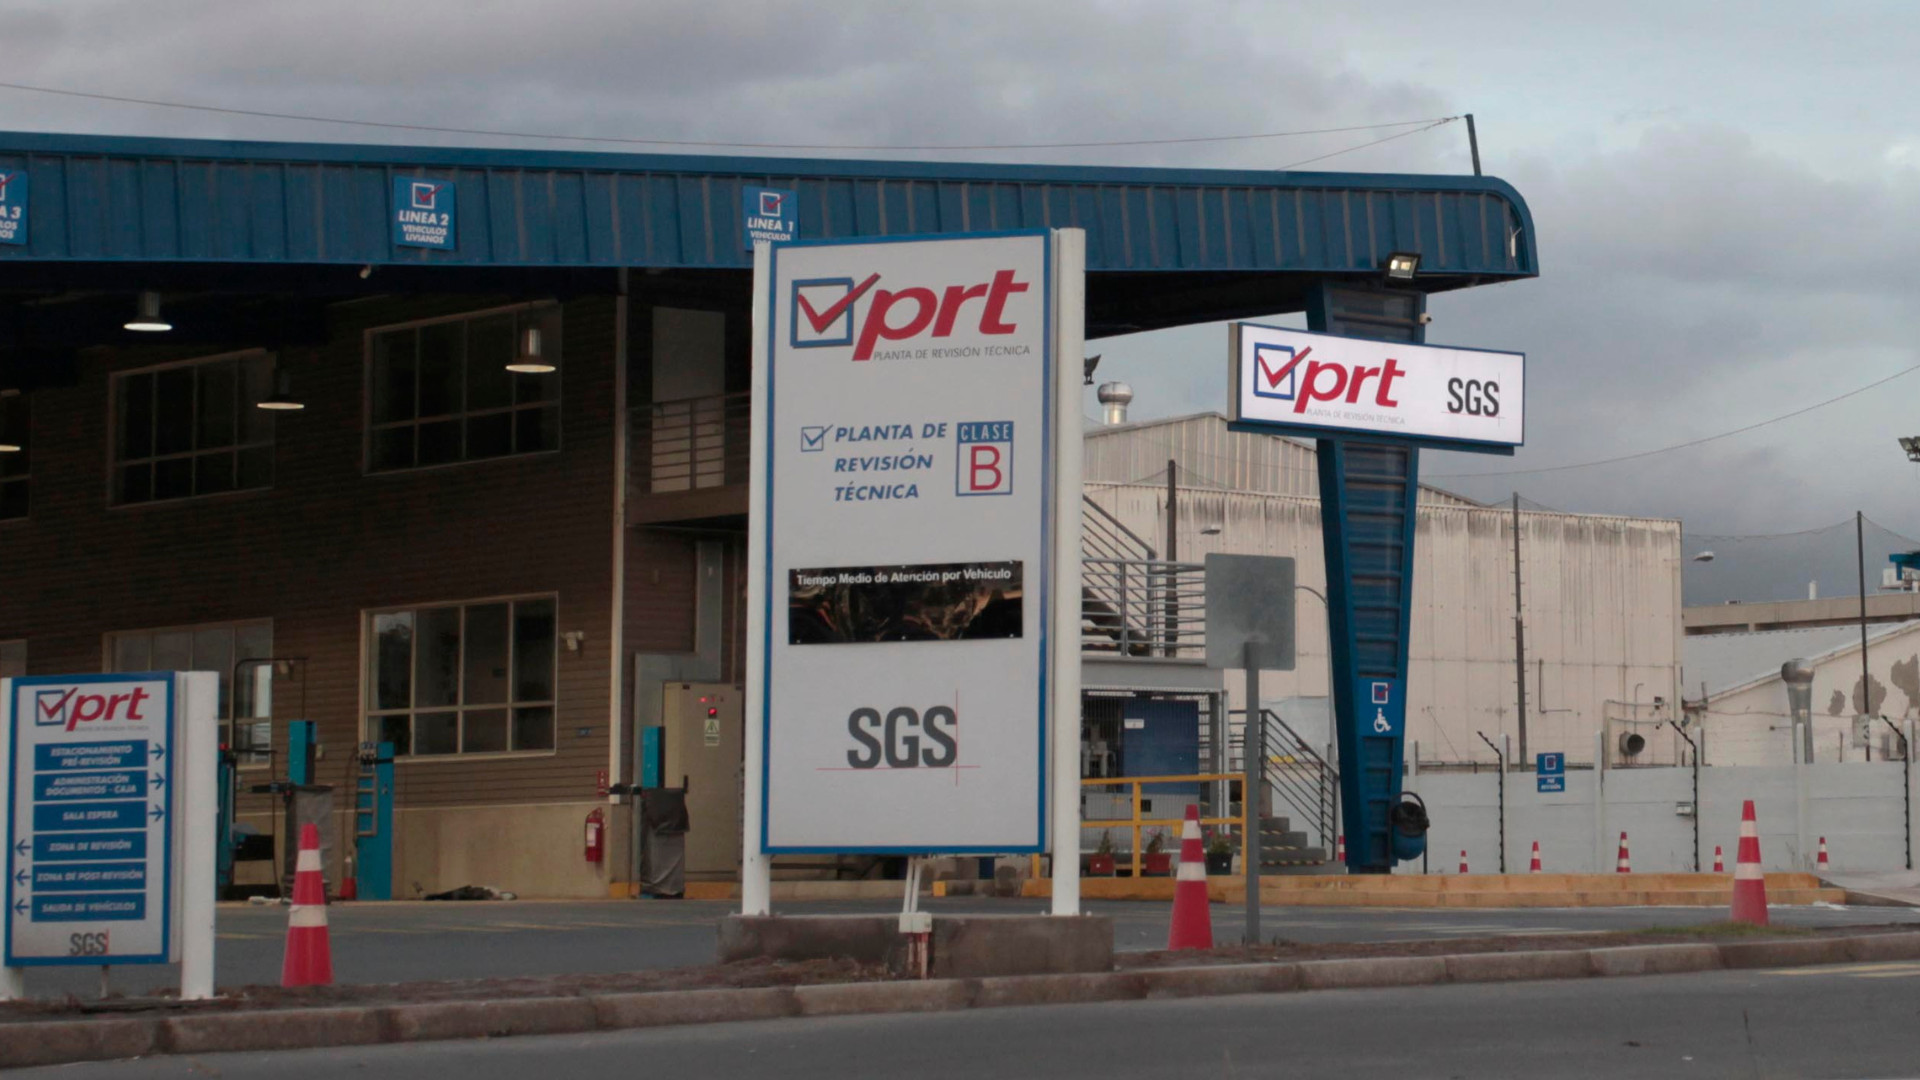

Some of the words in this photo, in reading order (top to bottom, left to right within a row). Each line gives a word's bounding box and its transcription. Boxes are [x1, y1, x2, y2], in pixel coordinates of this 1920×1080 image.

[11, 206, 21, 219] 3
[398, 210, 437, 225] LINEA
[441, 213, 449, 226] 2
[747, 217, 782, 231] LINEA
[788, 221, 794, 232] 1
[405, 233, 444, 244] LIVIANOS
[852, 270, 1029, 361] prt
[873, 350, 912, 361] PLANTA
[915, 349, 928, 359] DE
[1293, 358, 1406, 413] prt
[1447, 377, 1499, 417] SGS
[835, 424, 913, 442] PLANTA
[921, 423, 948, 439] DE
[961, 424, 1010, 440] CLASE
[834, 448, 933, 473] REVISIÓN
[970, 445, 1002, 491] B
[834, 481, 919, 502] TÉCNICA
[797, 574, 837, 587] Tiempo
[839, 572, 872, 584] Medio
[874, 573, 888, 583] de
[890, 571, 940, 583] Atención
[942, 571, 960, 583] por
[65, 687, 150, 732] prt
[847, 706, 957, 769] SGS
[50, 745, 133, 757] ESTACIONAMIENTO
[45, 785, 106, 796] DOCUMENTOS
[114, 784, 137, 794] CAJA
[63, 811, 84, 820] SALA
[87, 810, 119, 819] ESPERA
[48, 842, 75, 852] ZONA
[77, 842, 88, 851] DE
[36, 872, 62, 882] ZONA
[65, 872, 76, 881] DE
[75, 903, 86, 912] DE
[69, 932, 107, 956] SGS
